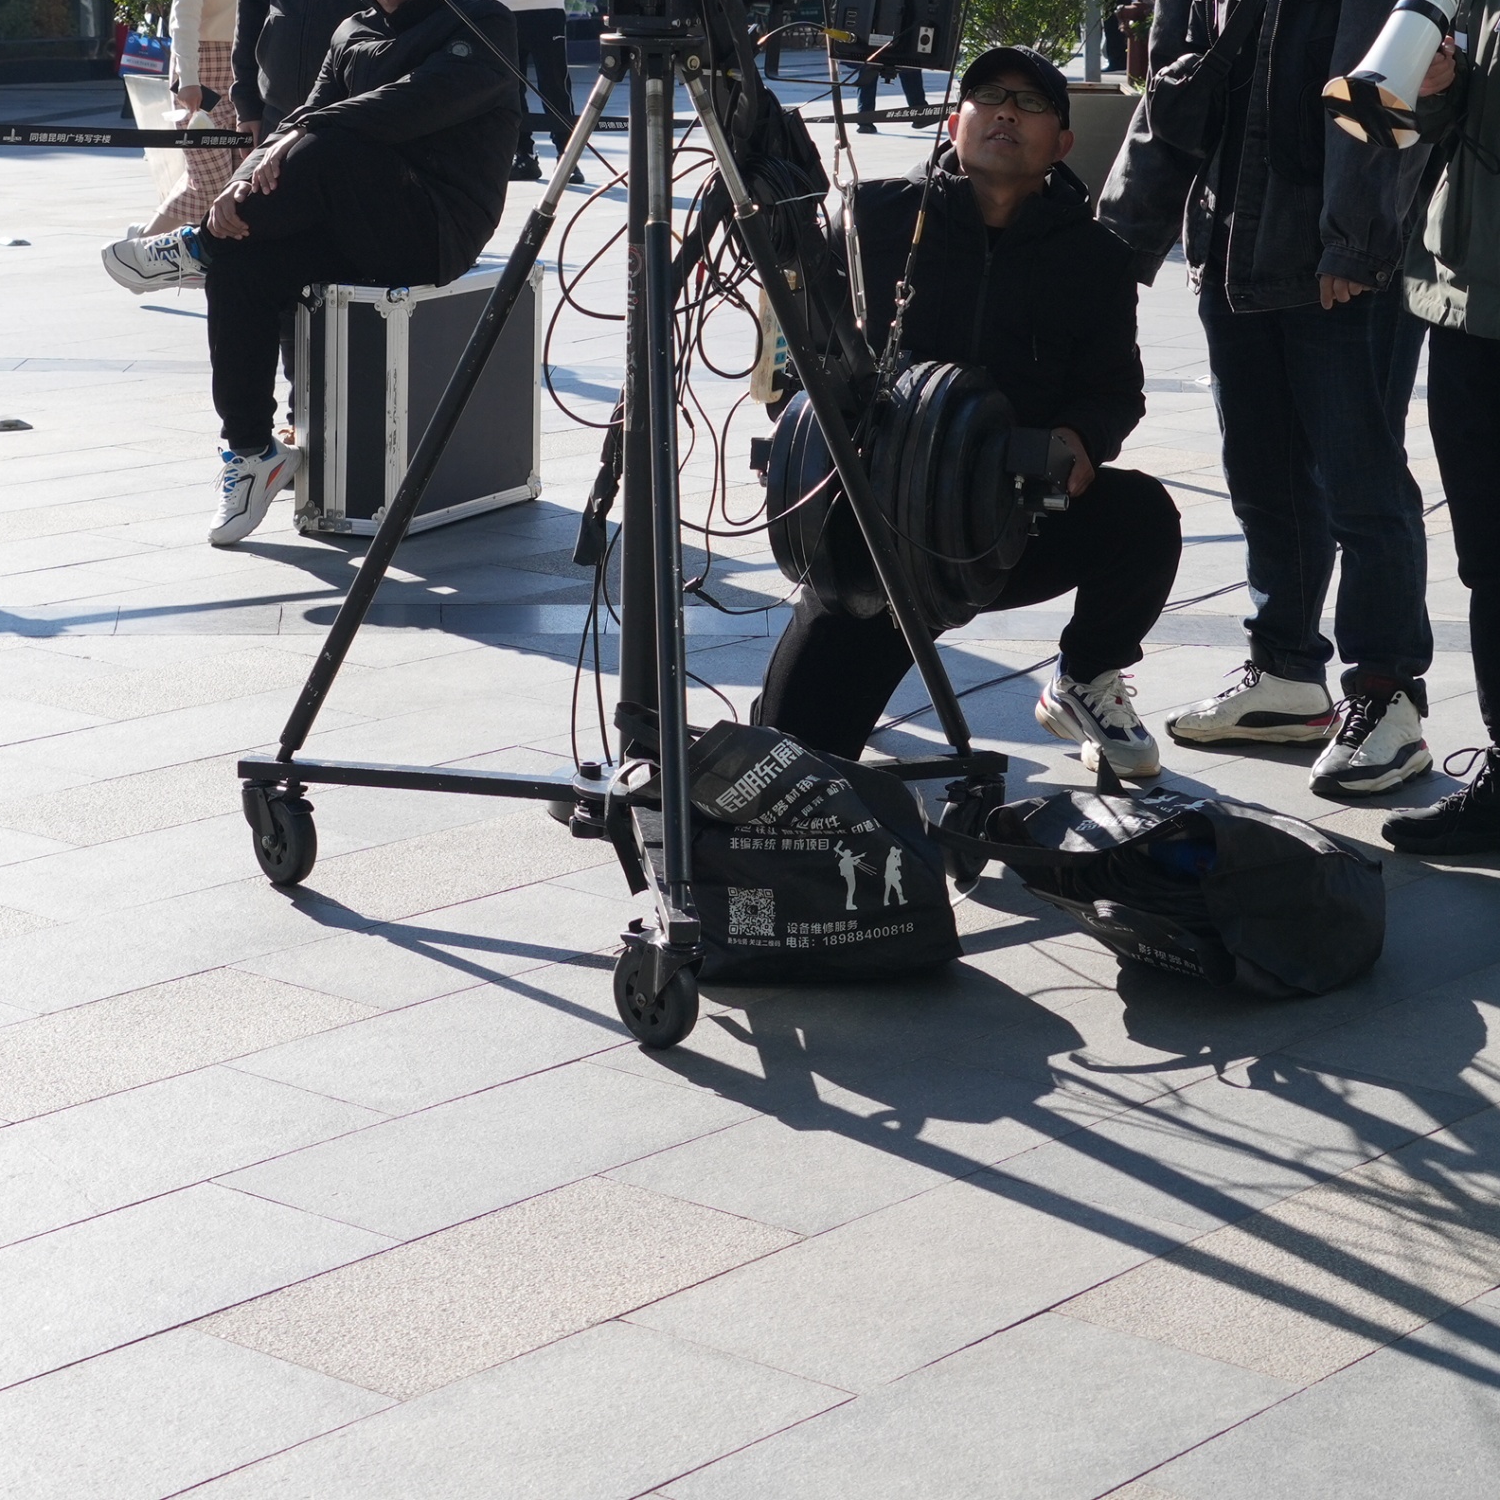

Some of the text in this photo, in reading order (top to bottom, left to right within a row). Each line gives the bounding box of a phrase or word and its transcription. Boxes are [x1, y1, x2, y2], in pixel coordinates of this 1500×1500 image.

[29, 132, 112, 145] 同德昆明广场写字楼
[729, 837, 830, 851] 非编系统 集成项目
[786, 919, 858, 936] 设备维修服务
[822, 922, 914, 947] 18988400818
